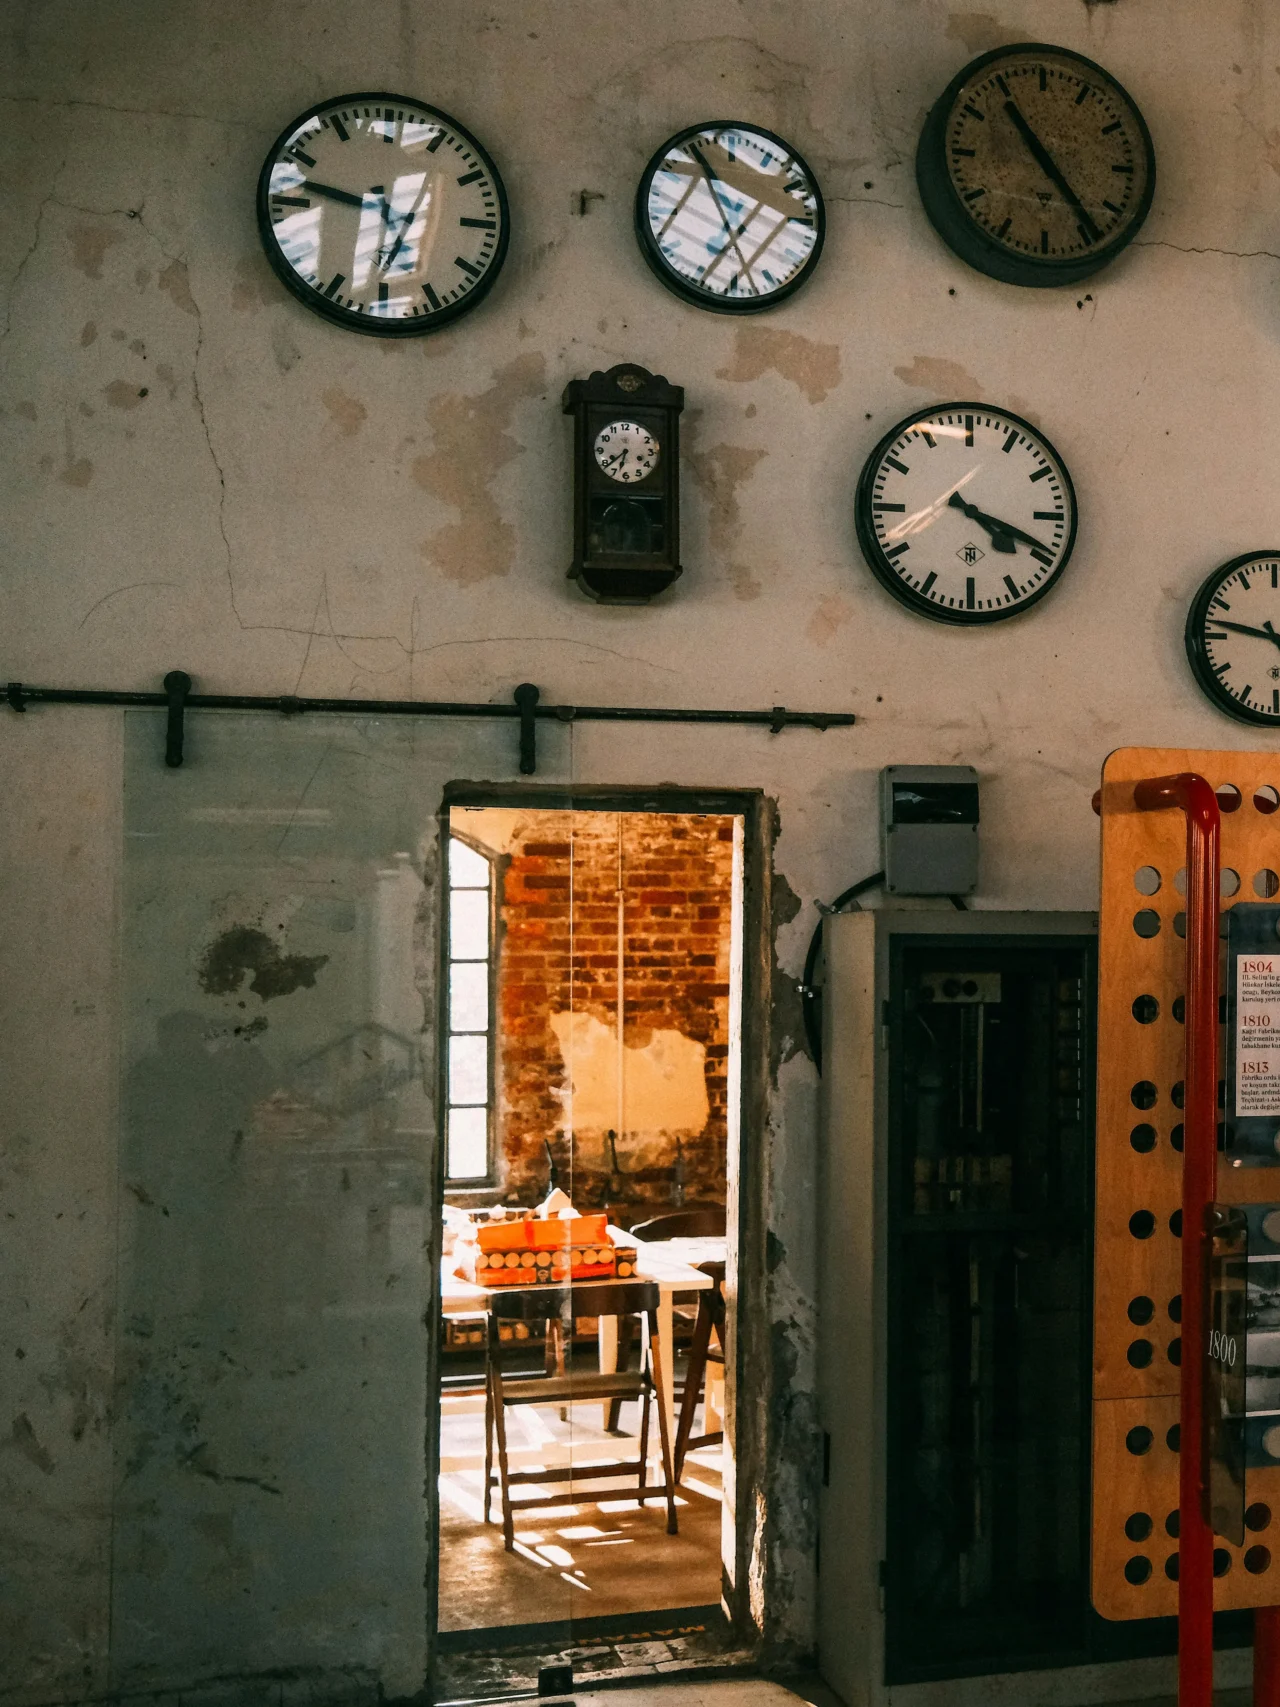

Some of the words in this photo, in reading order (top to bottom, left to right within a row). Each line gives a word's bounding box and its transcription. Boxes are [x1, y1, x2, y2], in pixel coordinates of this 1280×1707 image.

[611, 468, 617, 476] 7
[1242, 961, 1273, 973] 1804
[1243, 1015, 1270, 1026] 1810
[1242, 1062, 1269, 1073] 1813
[1208, 1329, 1236, 1367] 1800
